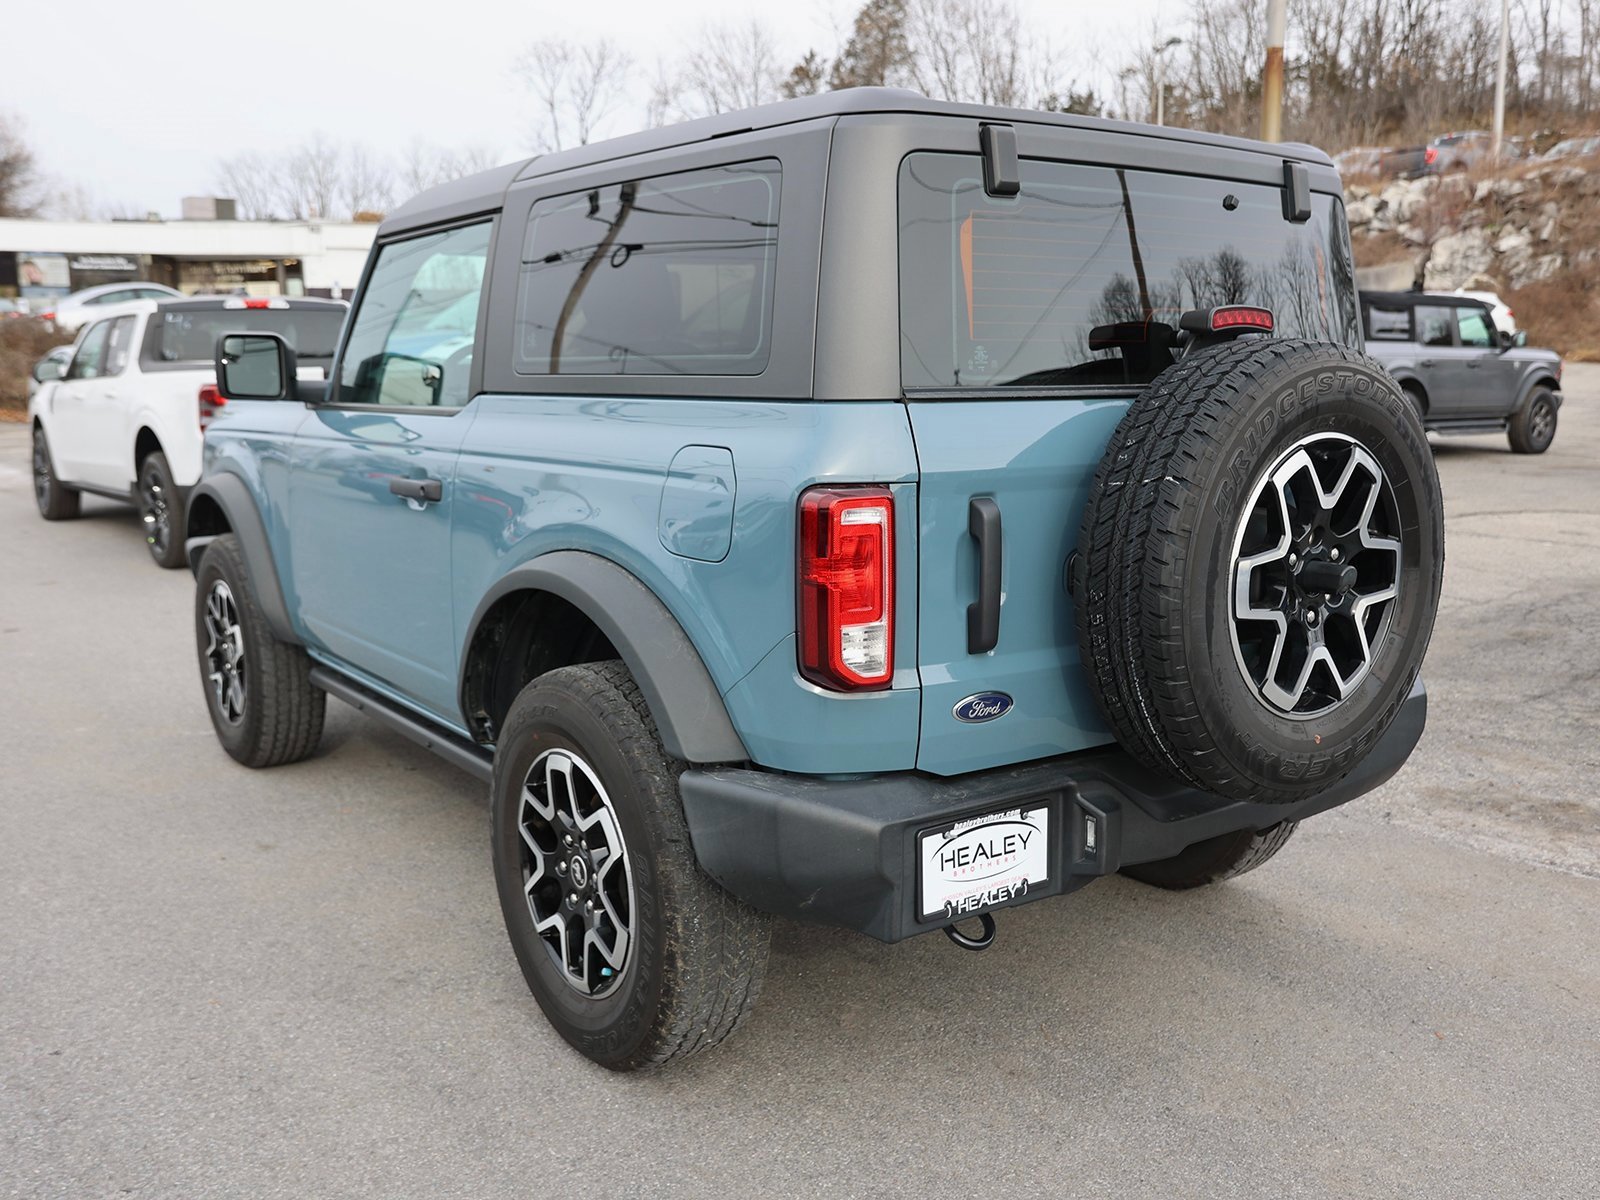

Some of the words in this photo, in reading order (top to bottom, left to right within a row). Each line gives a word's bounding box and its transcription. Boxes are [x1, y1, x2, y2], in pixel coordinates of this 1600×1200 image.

[1213, 370, 1405, 519] BRIDGESTONE
[968, 700, 1001, 718] Ford
[953, 809, 1021, 831] healeybrothers.com
[940, 830, 1033, 872] HEALEY
[953, 855, 1017, 877] BROTHERS
[956, 882, 1018, 915] HEALEY
